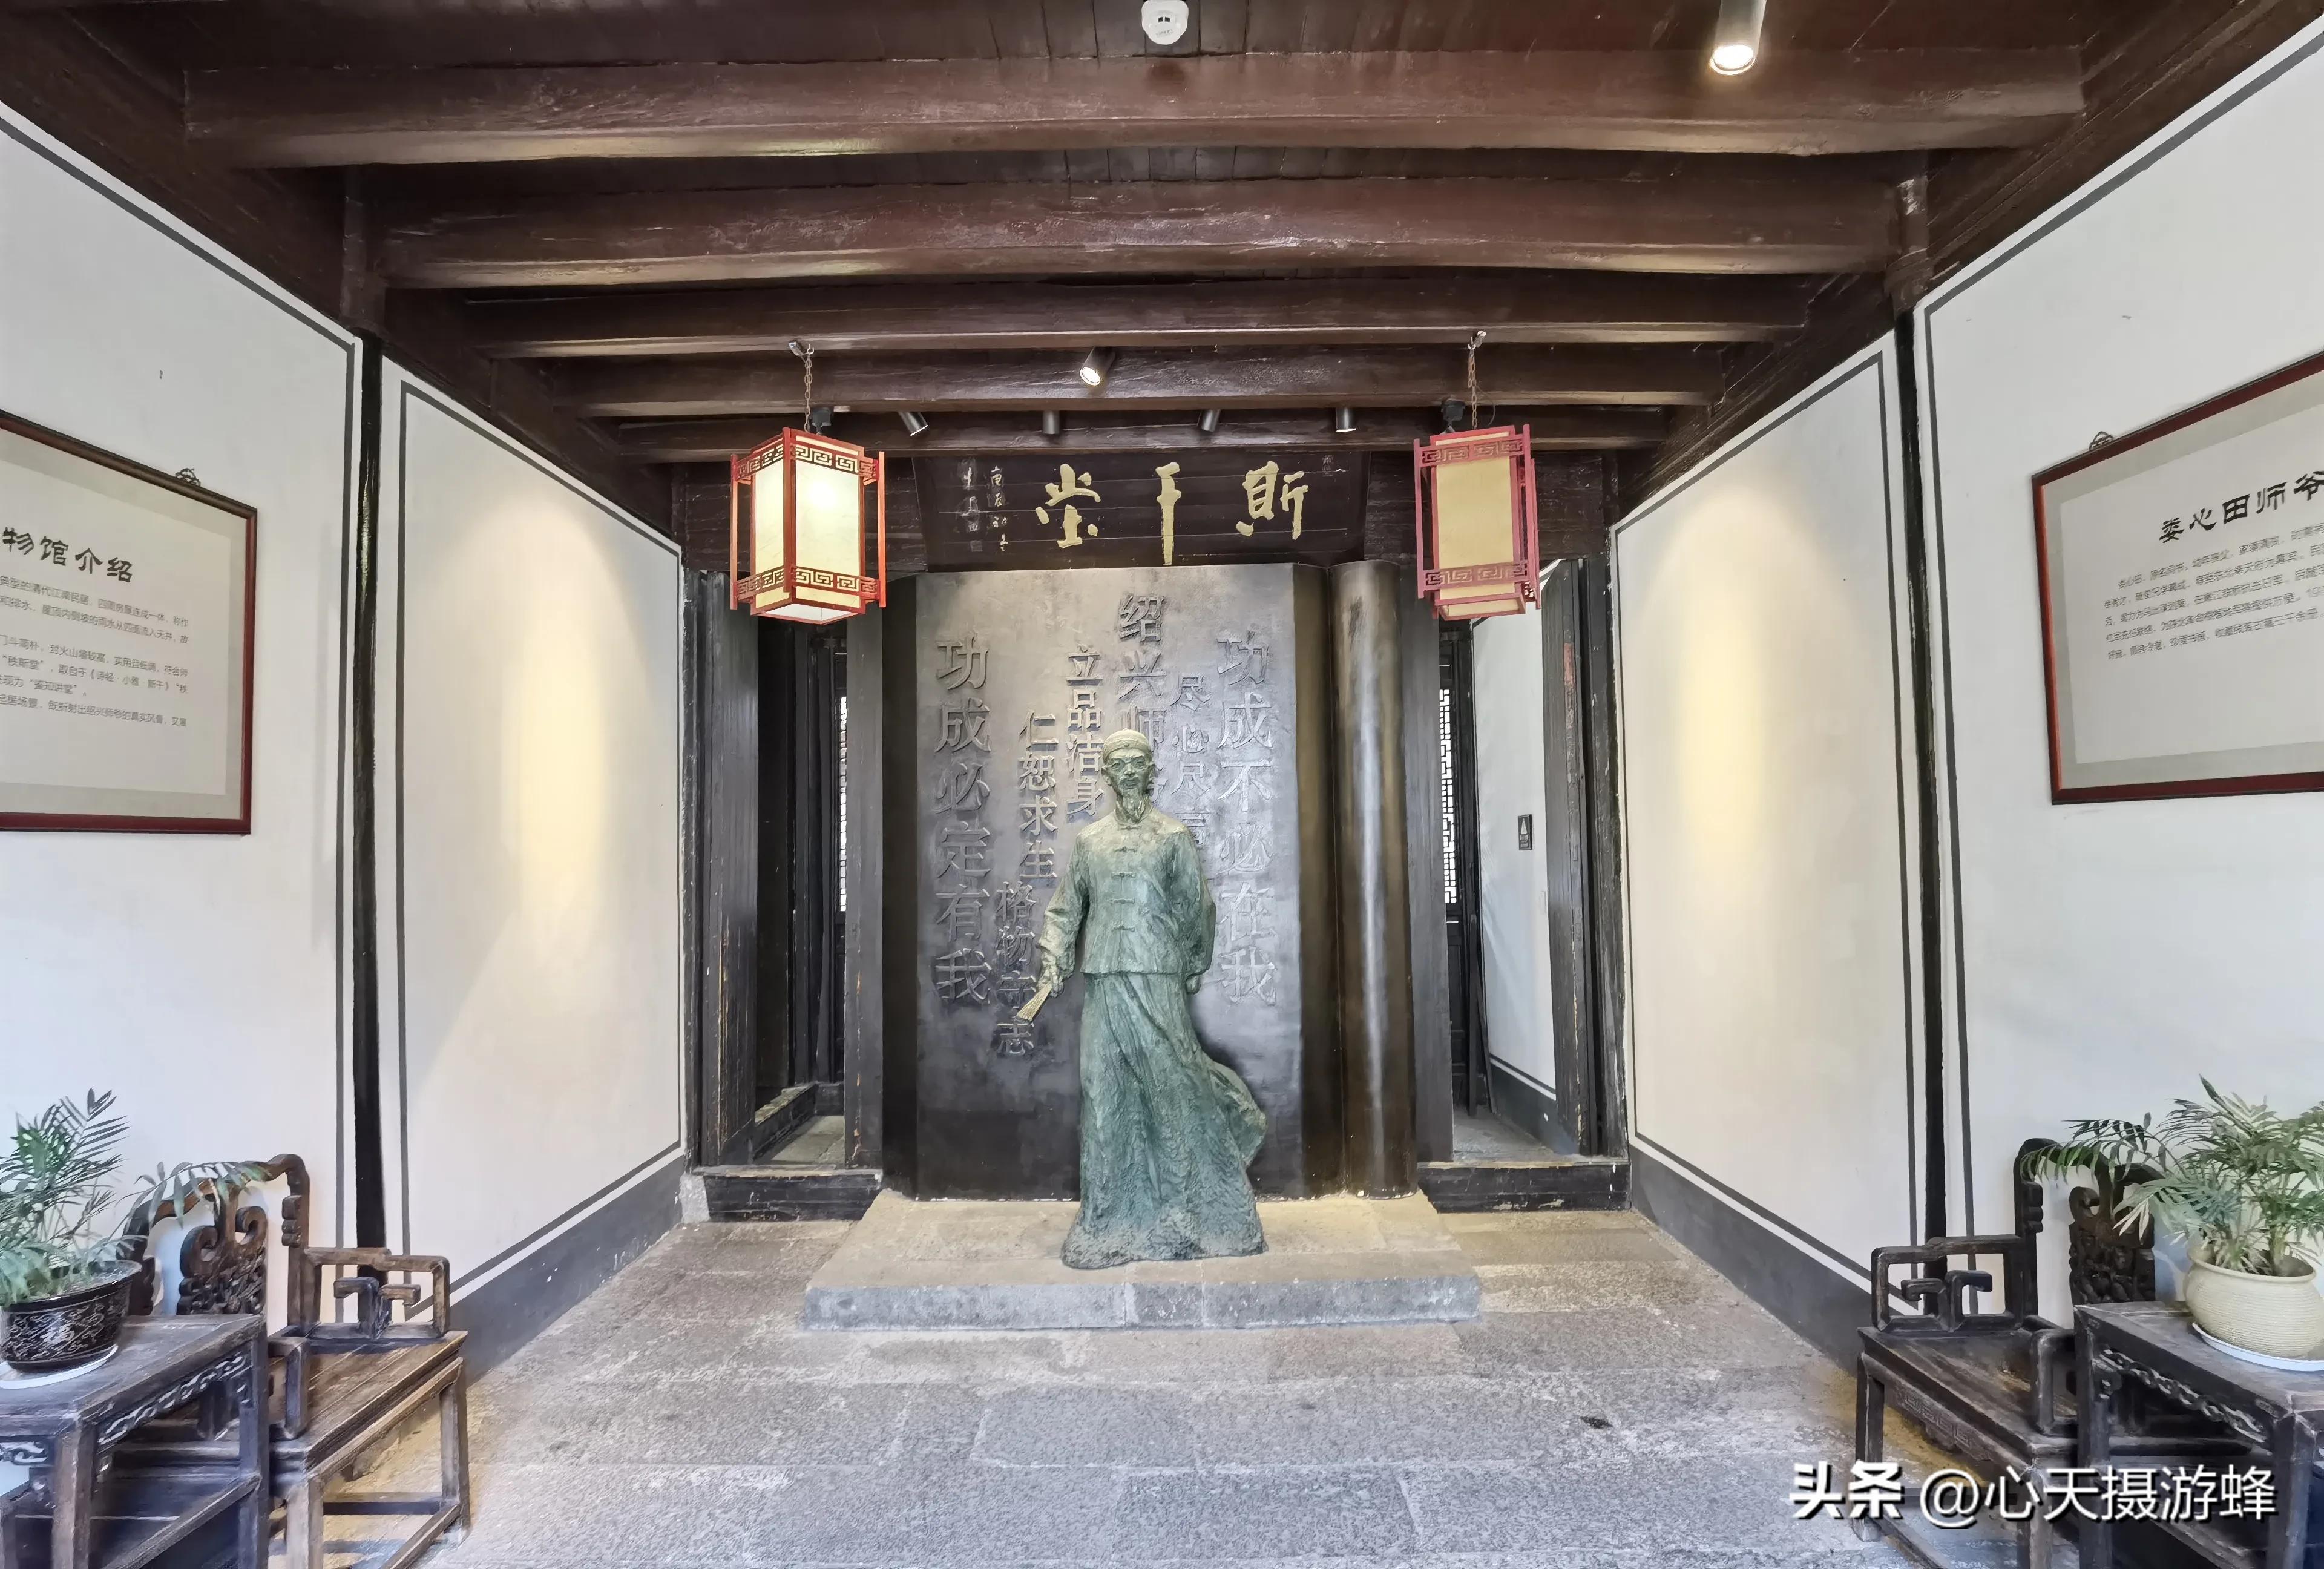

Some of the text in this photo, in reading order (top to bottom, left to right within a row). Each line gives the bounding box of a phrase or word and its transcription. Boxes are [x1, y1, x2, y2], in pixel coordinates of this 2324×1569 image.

[2, 527, 133, 583] 物馆介绍
[2159, 470, 2324, 544] 娄心田师爷
[1066, 646, 1104, 818] 立品洁身
[1118, 595, 1167, 806] 绍兴师
[935, 632, 993, 1006] 功成必定有我
[1019, 710, 1059, 880] 仁恕求生
[1216, 631, 1278, 1006] 功成不必在我
